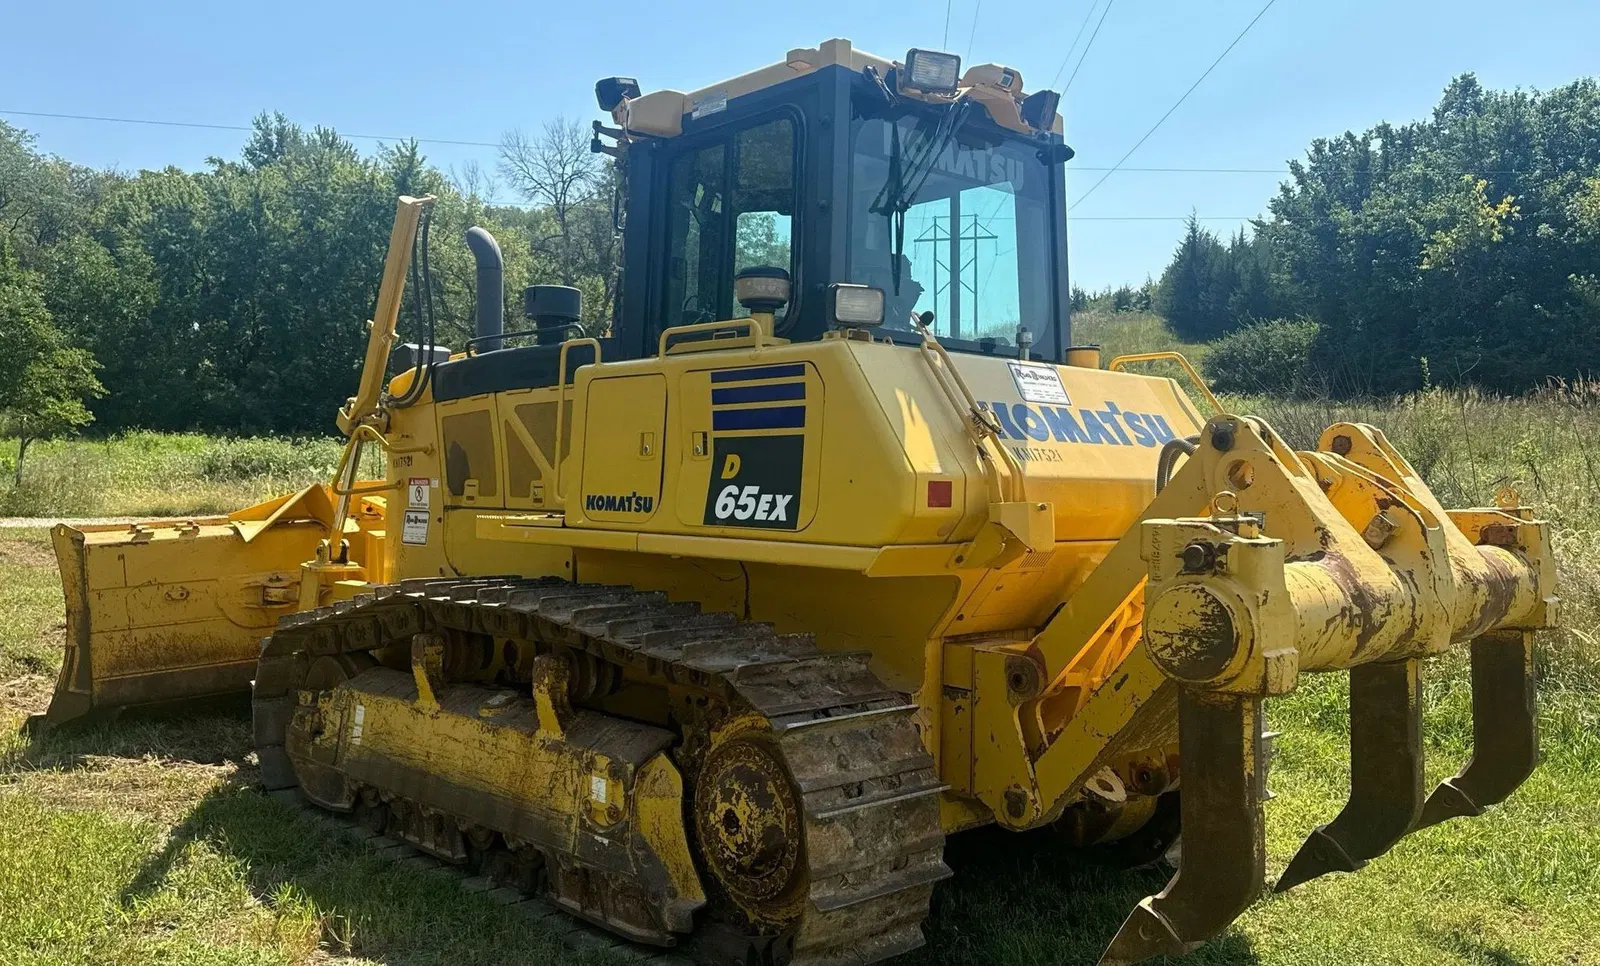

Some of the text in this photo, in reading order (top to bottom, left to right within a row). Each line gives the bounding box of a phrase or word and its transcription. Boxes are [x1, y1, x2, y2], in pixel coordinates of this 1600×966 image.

[976, 401, 1175, 448] KOMATSU
[720, 453, 741, 480] D
[586, 491, 653, 513] KOMATSU
[714, 484, 793, 521] 65EX
